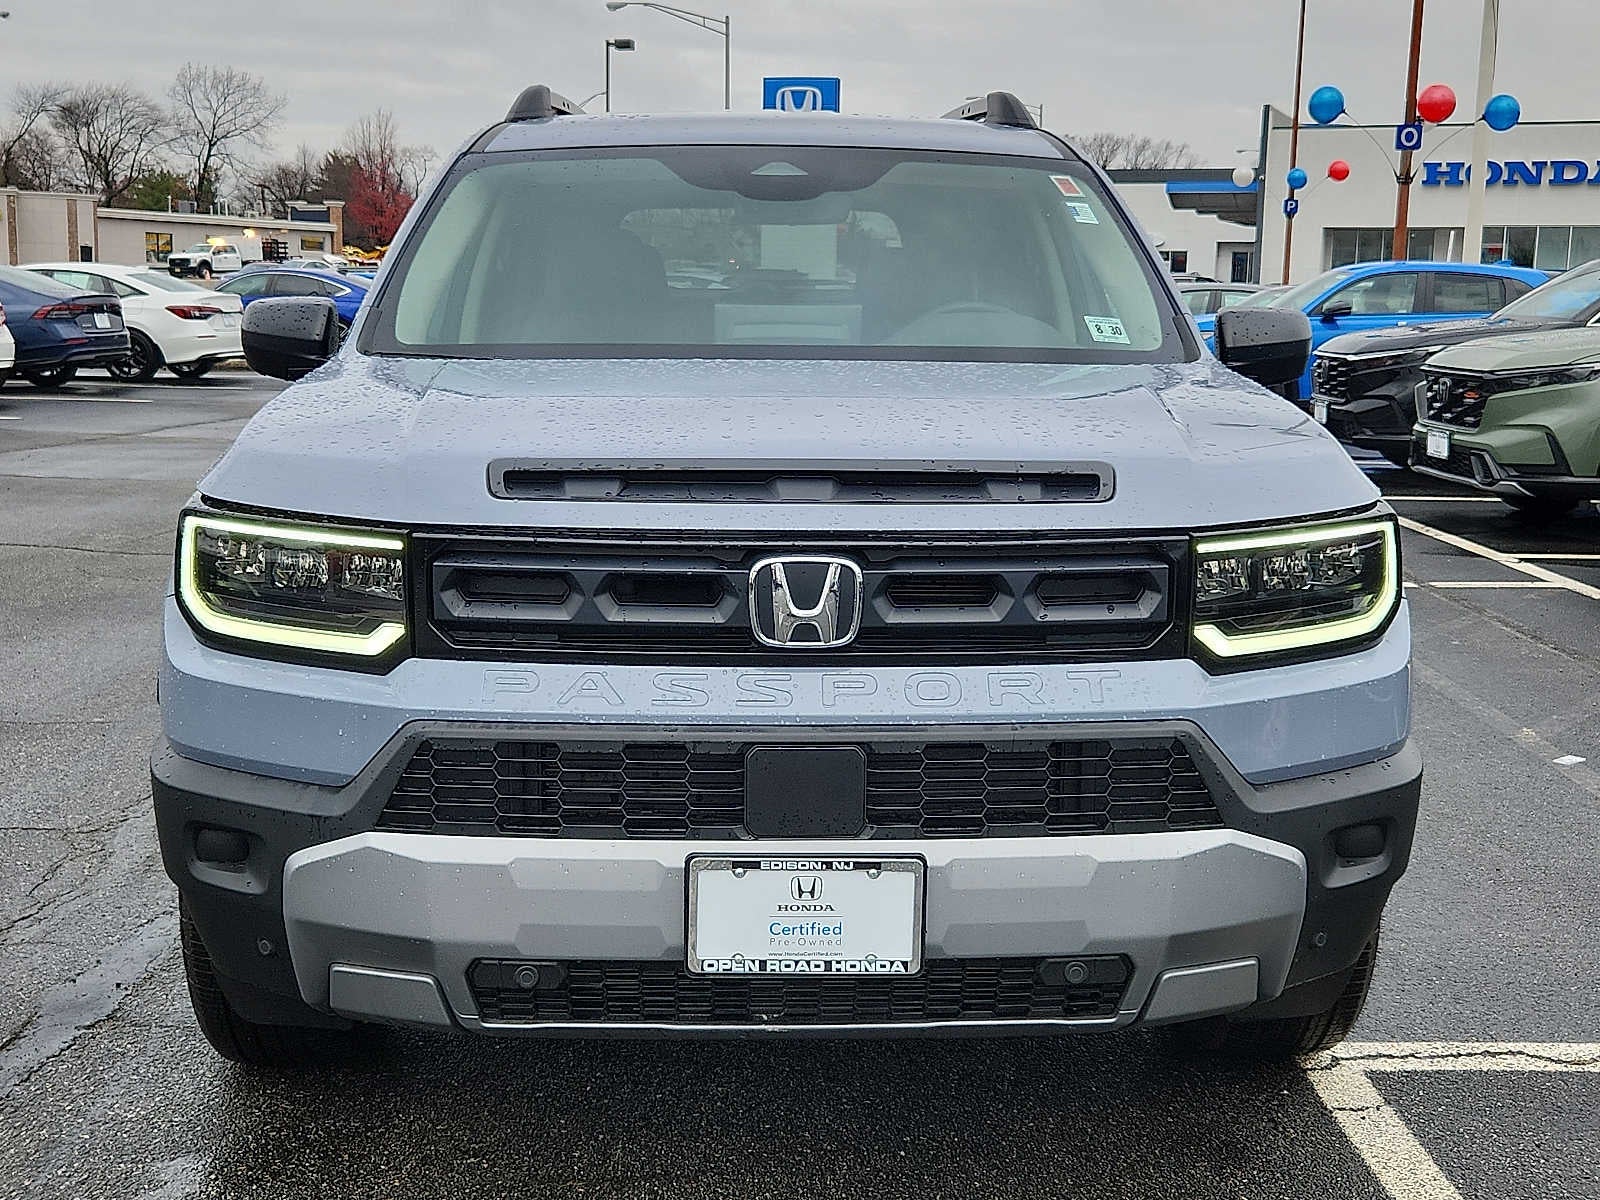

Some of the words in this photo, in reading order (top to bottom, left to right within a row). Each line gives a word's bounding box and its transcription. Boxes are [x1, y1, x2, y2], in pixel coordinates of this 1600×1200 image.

[1400, 127, 1419, 147] O
[1286, 200, 1296, 212] P
[1094, 323, 1104, 334] 8
[1108, 325, 1123, 336] 30
[482, 669, 1122, 707] PASSPORT
[832, 860, 854, 871] NJ
[776, 904, 835, 912] HONDA
[769, 921, 842, 936] Certified
[769, 937, 842, 946] Pre-Owned
[702, 959, 759, 973] OPEN
[766, 959, 825, 973] ROAD
[831, 959, 906, 973] HONDA
